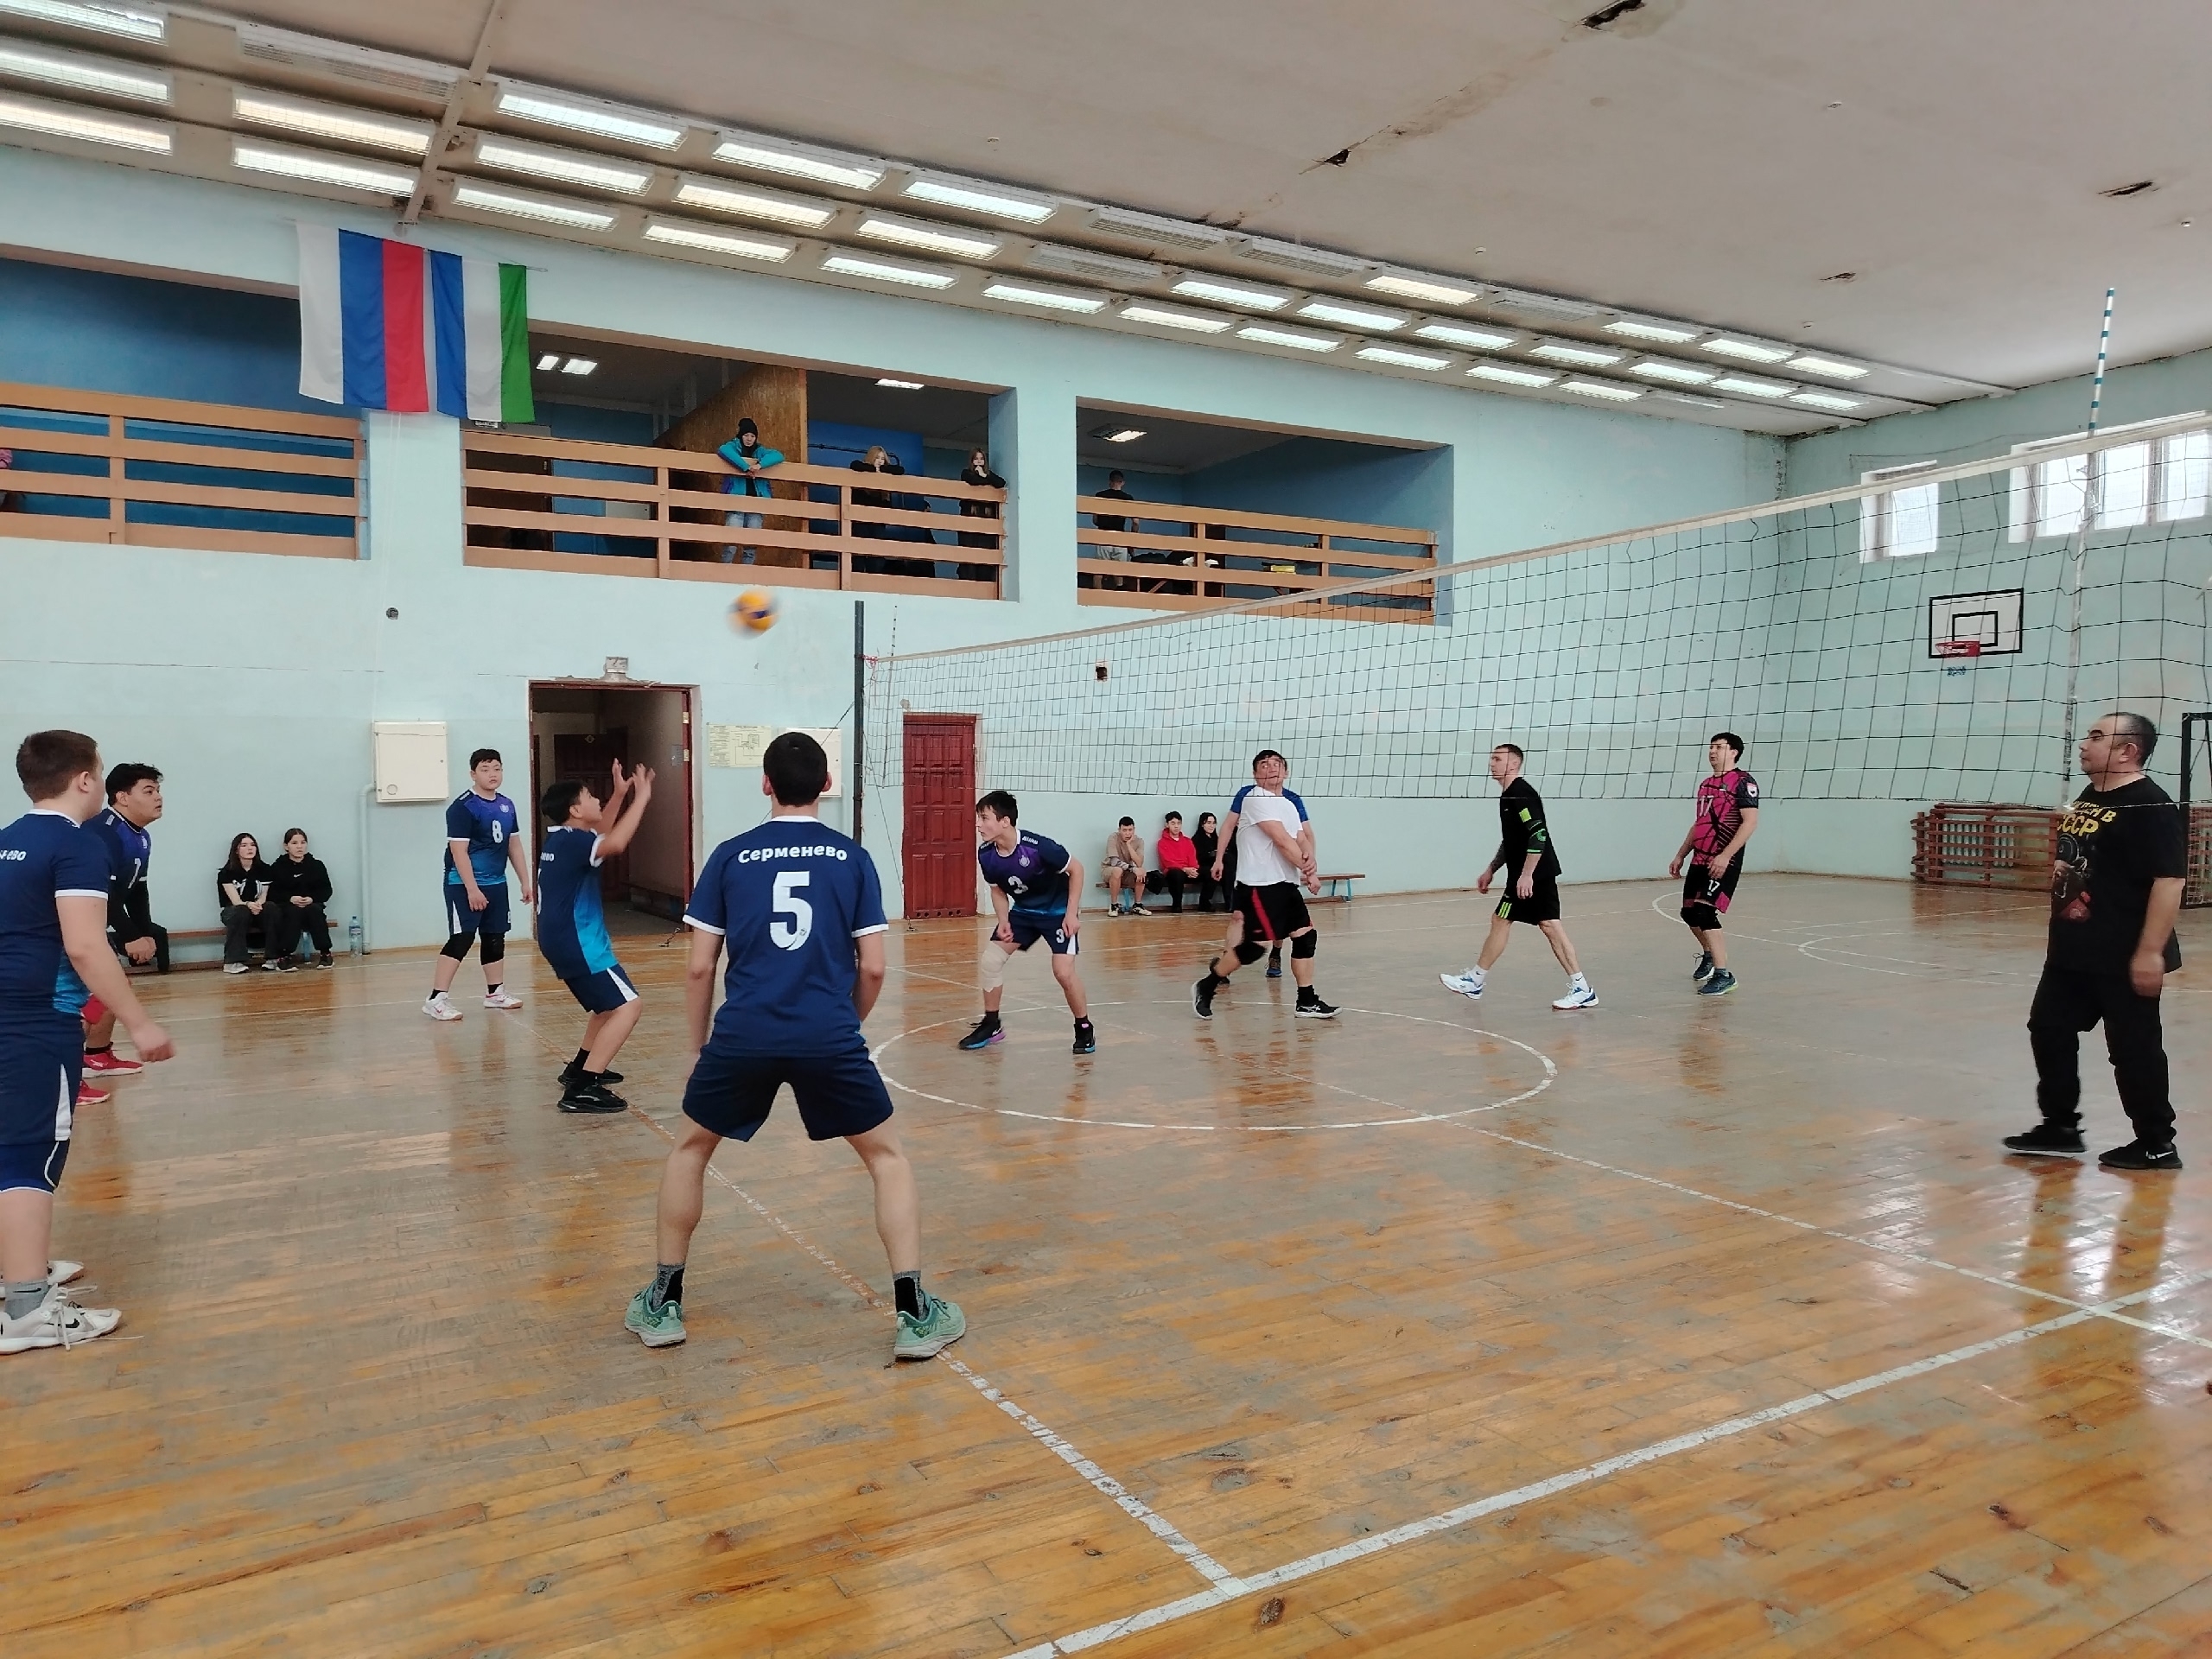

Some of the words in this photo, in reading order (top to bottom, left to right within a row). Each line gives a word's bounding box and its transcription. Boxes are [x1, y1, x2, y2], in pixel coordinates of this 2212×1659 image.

[1699, 795, 1714, 817] 17
[492, 819, 504, 844] 8
[737, 845, 848, 864] Серменево
[127, 857, 142, 889] 7
[1007, 874, 1029, 894] 3
[1707, 879, 1720, 893] 17
[769, 870, 813, 951] 5
[1055, 928, 1065, 944] 3
